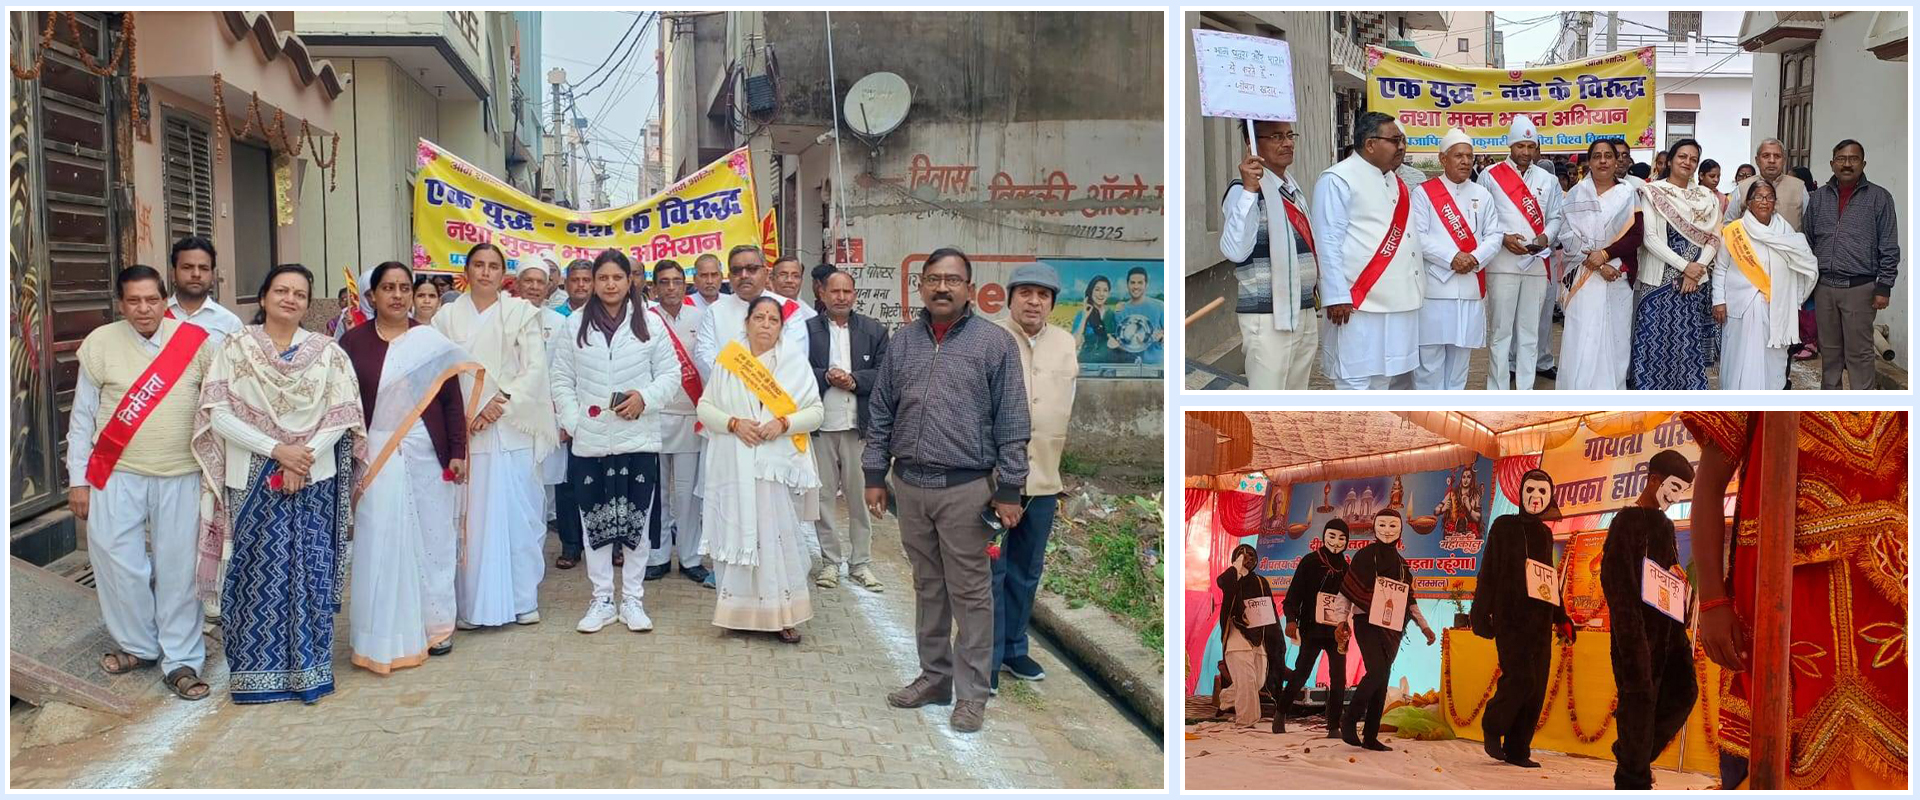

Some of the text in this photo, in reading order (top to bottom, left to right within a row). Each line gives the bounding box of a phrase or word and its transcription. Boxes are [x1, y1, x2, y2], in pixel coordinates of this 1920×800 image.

[1377, 77, 1423, 98] एक
[1427, 81, 1476, 108] युद्ध
[1499, 80, 1541, 100] नशे
[1545, 77, 1572, 100] के
[1577, 74, 1646, 100] विरुद्ध
[1399, 110, 1441, 126] नशा
[1446, 111, 1494, 133] मुक्त
[1552, 104, 1628, 126] अभियान
[1556, 133, 1581, 144] विश्व
[424, 178, 476, 209] एक
[479, 198, 537, 231] युद्ध
[657, 188, 742, 230] विरुद्ध
[446, 220, 493, 243] नशा
[630, 231, 722, 262] अभियान
[1379, 578, 1405, 593] शराब
[1533, 563, 1553, 585] पान
